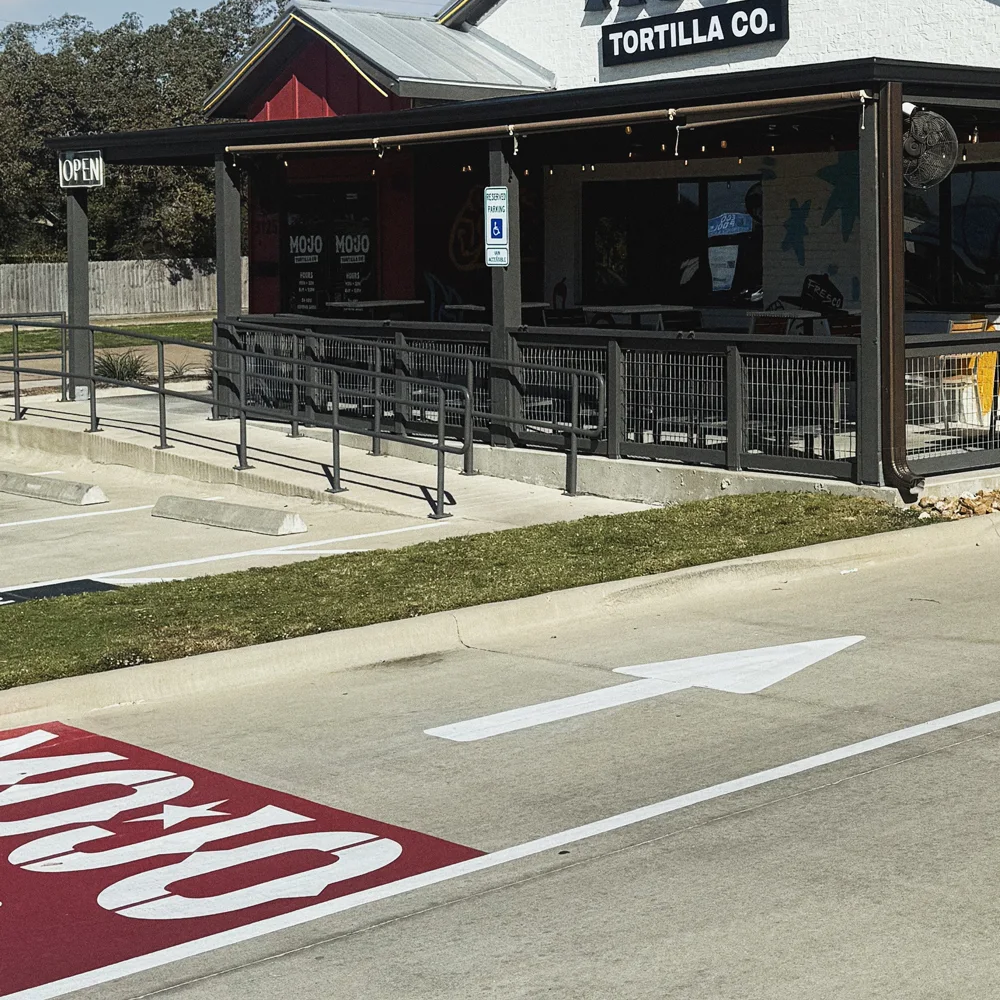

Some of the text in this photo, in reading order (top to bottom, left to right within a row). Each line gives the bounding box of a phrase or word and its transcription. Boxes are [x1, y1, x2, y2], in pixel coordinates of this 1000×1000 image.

[608, 7, 776, 56] TORTILLA CO.
[63, 157, 99, 181] OPEN
[486, 192, 506, 201] RESERVED
[488, 205, 505, 213] PARKING
[289, 235, 323, 253] MOJO
[335, 234, 370, 253] MOJO
[807, 278, 842, 308] FRESCO
